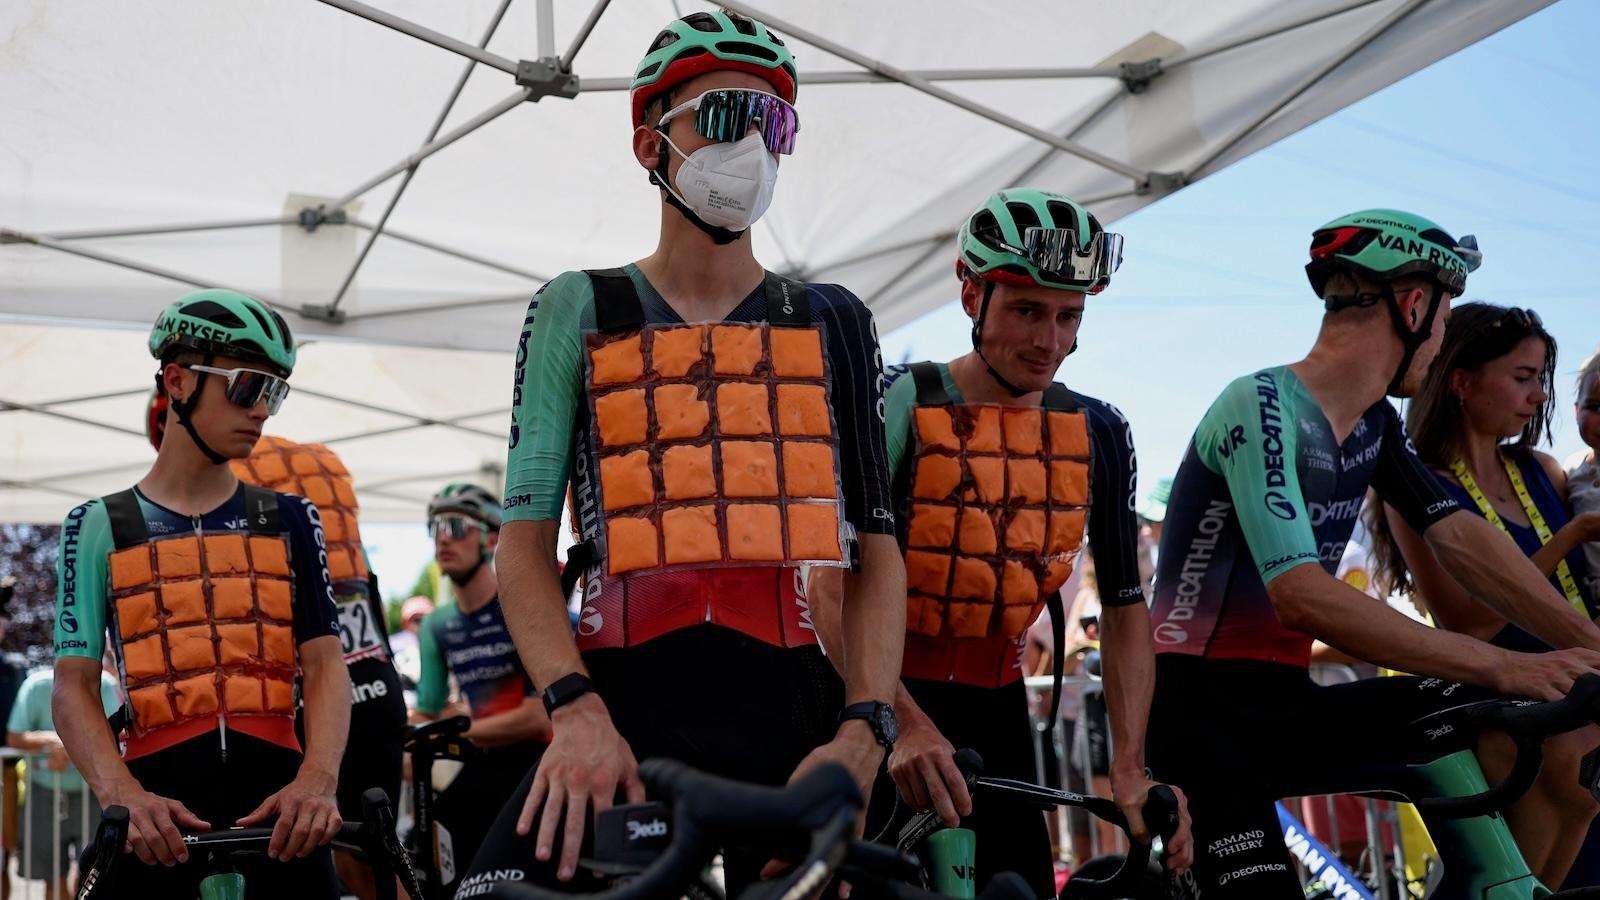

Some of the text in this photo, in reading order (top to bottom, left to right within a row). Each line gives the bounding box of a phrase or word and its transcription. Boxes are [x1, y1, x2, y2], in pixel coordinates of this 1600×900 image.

[1366, 218, 1417, 233] DECATHLON
[1377, 231, 1424, 258] VAN
[1255, 372, 1286, 487] DECATHLO
[1171, 500, 1233, 621] DECATHLON
[1320, 542, 1345, 560] CG
[1208, 829, 1265, 853] ARMAND
[1215, 838, 1264, 858] THIERY
[1284, 825, 1326, 874] VAN
[1233, 863, 1287, 880] DECATHLON
